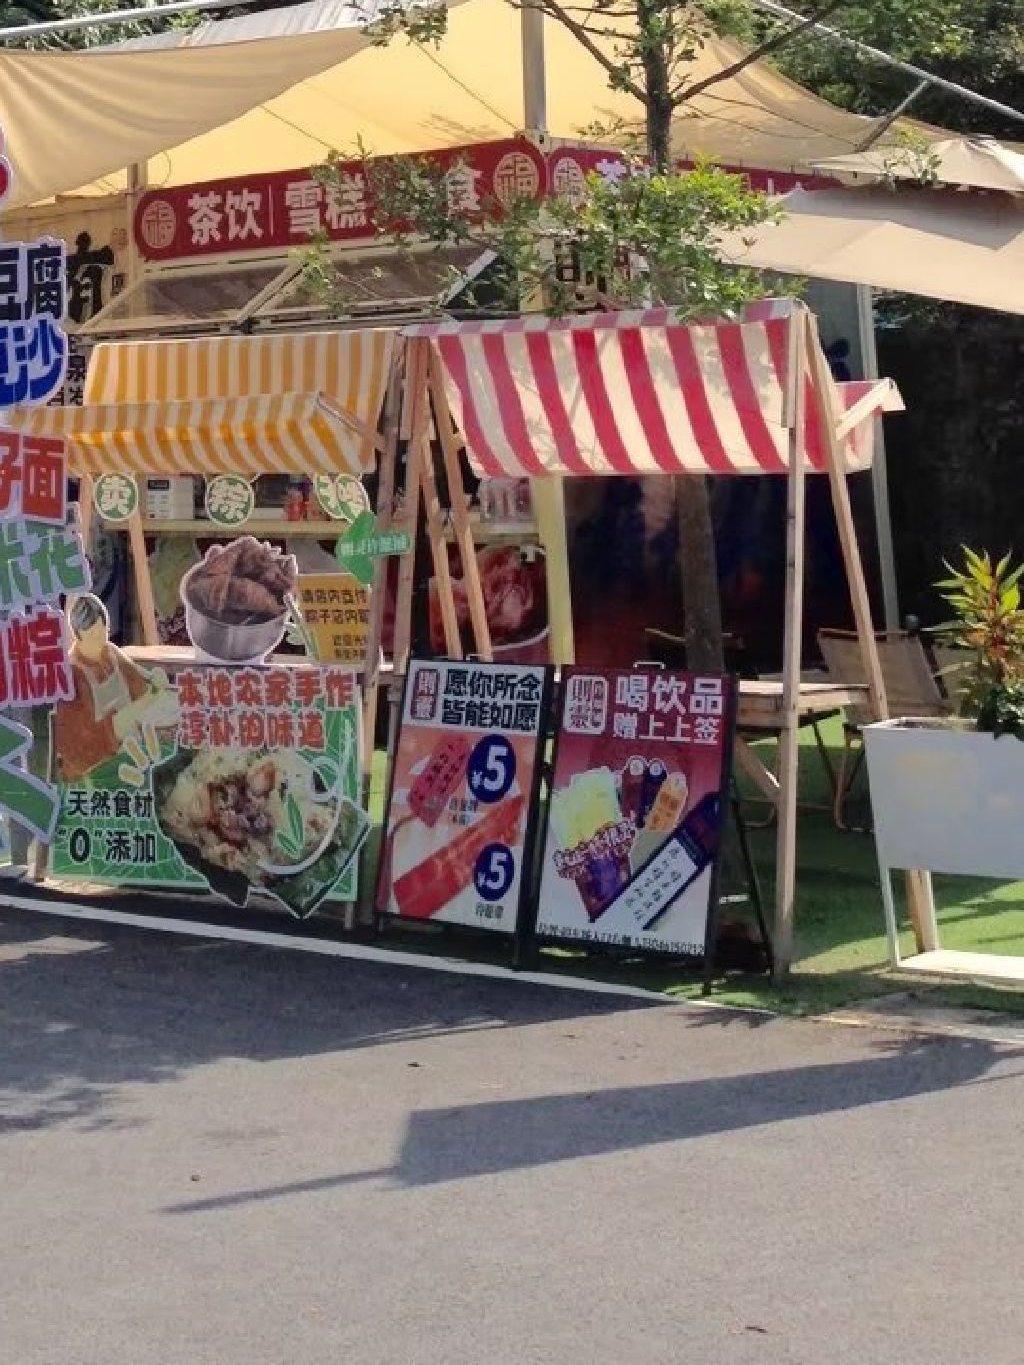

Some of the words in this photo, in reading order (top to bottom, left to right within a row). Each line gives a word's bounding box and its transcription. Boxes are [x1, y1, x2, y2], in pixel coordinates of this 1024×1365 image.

[187, 191, 263, 246] 茶饮
[285, 173, 367, 235] 雪糕
[177, 669, 354, 708] 本地农家手作
[444, 669, 540, 701] 愿你所念
[615, 674, 723, 714] 喝饮品
[442, 698, 538, 731] 皆能如愿
[67, 790, 153, 819] 天然食材
